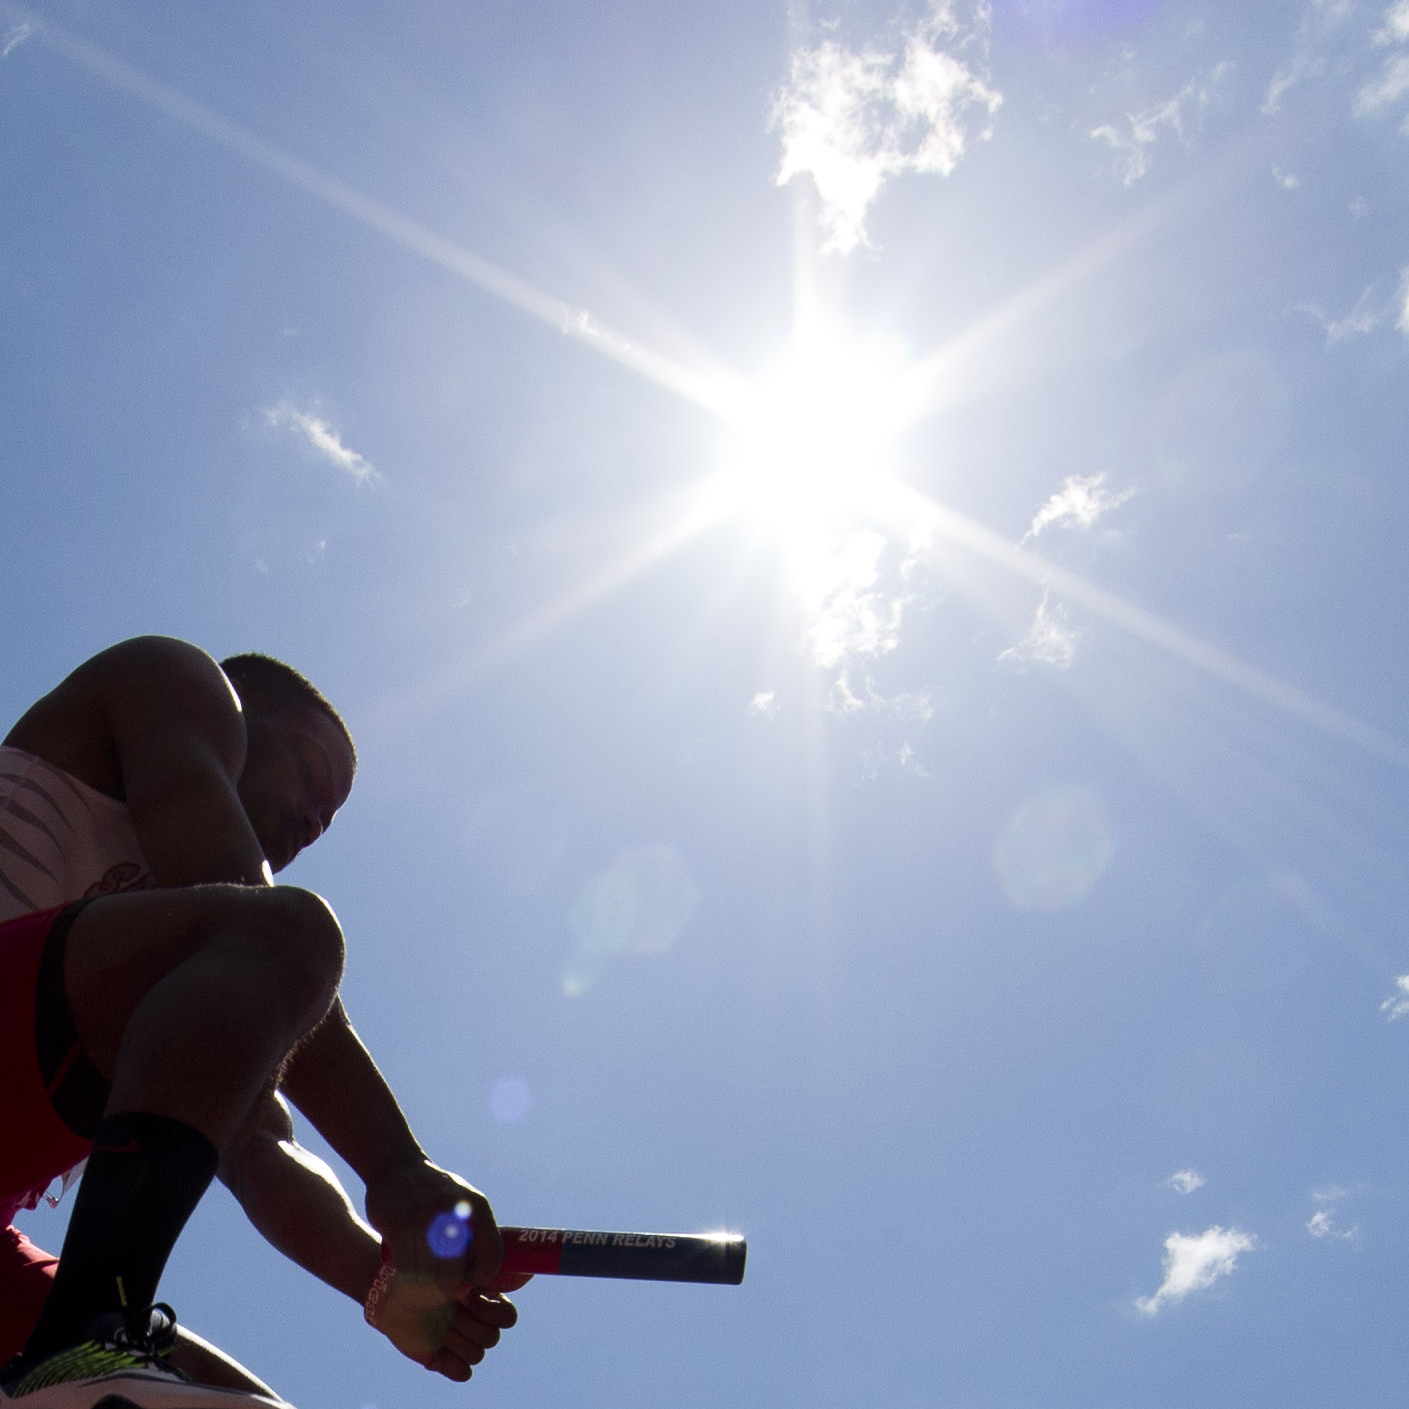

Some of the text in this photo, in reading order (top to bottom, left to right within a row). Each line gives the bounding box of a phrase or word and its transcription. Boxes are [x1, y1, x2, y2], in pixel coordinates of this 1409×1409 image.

[519, 1229, 676, 1249] 2014 PENN RELAYS
